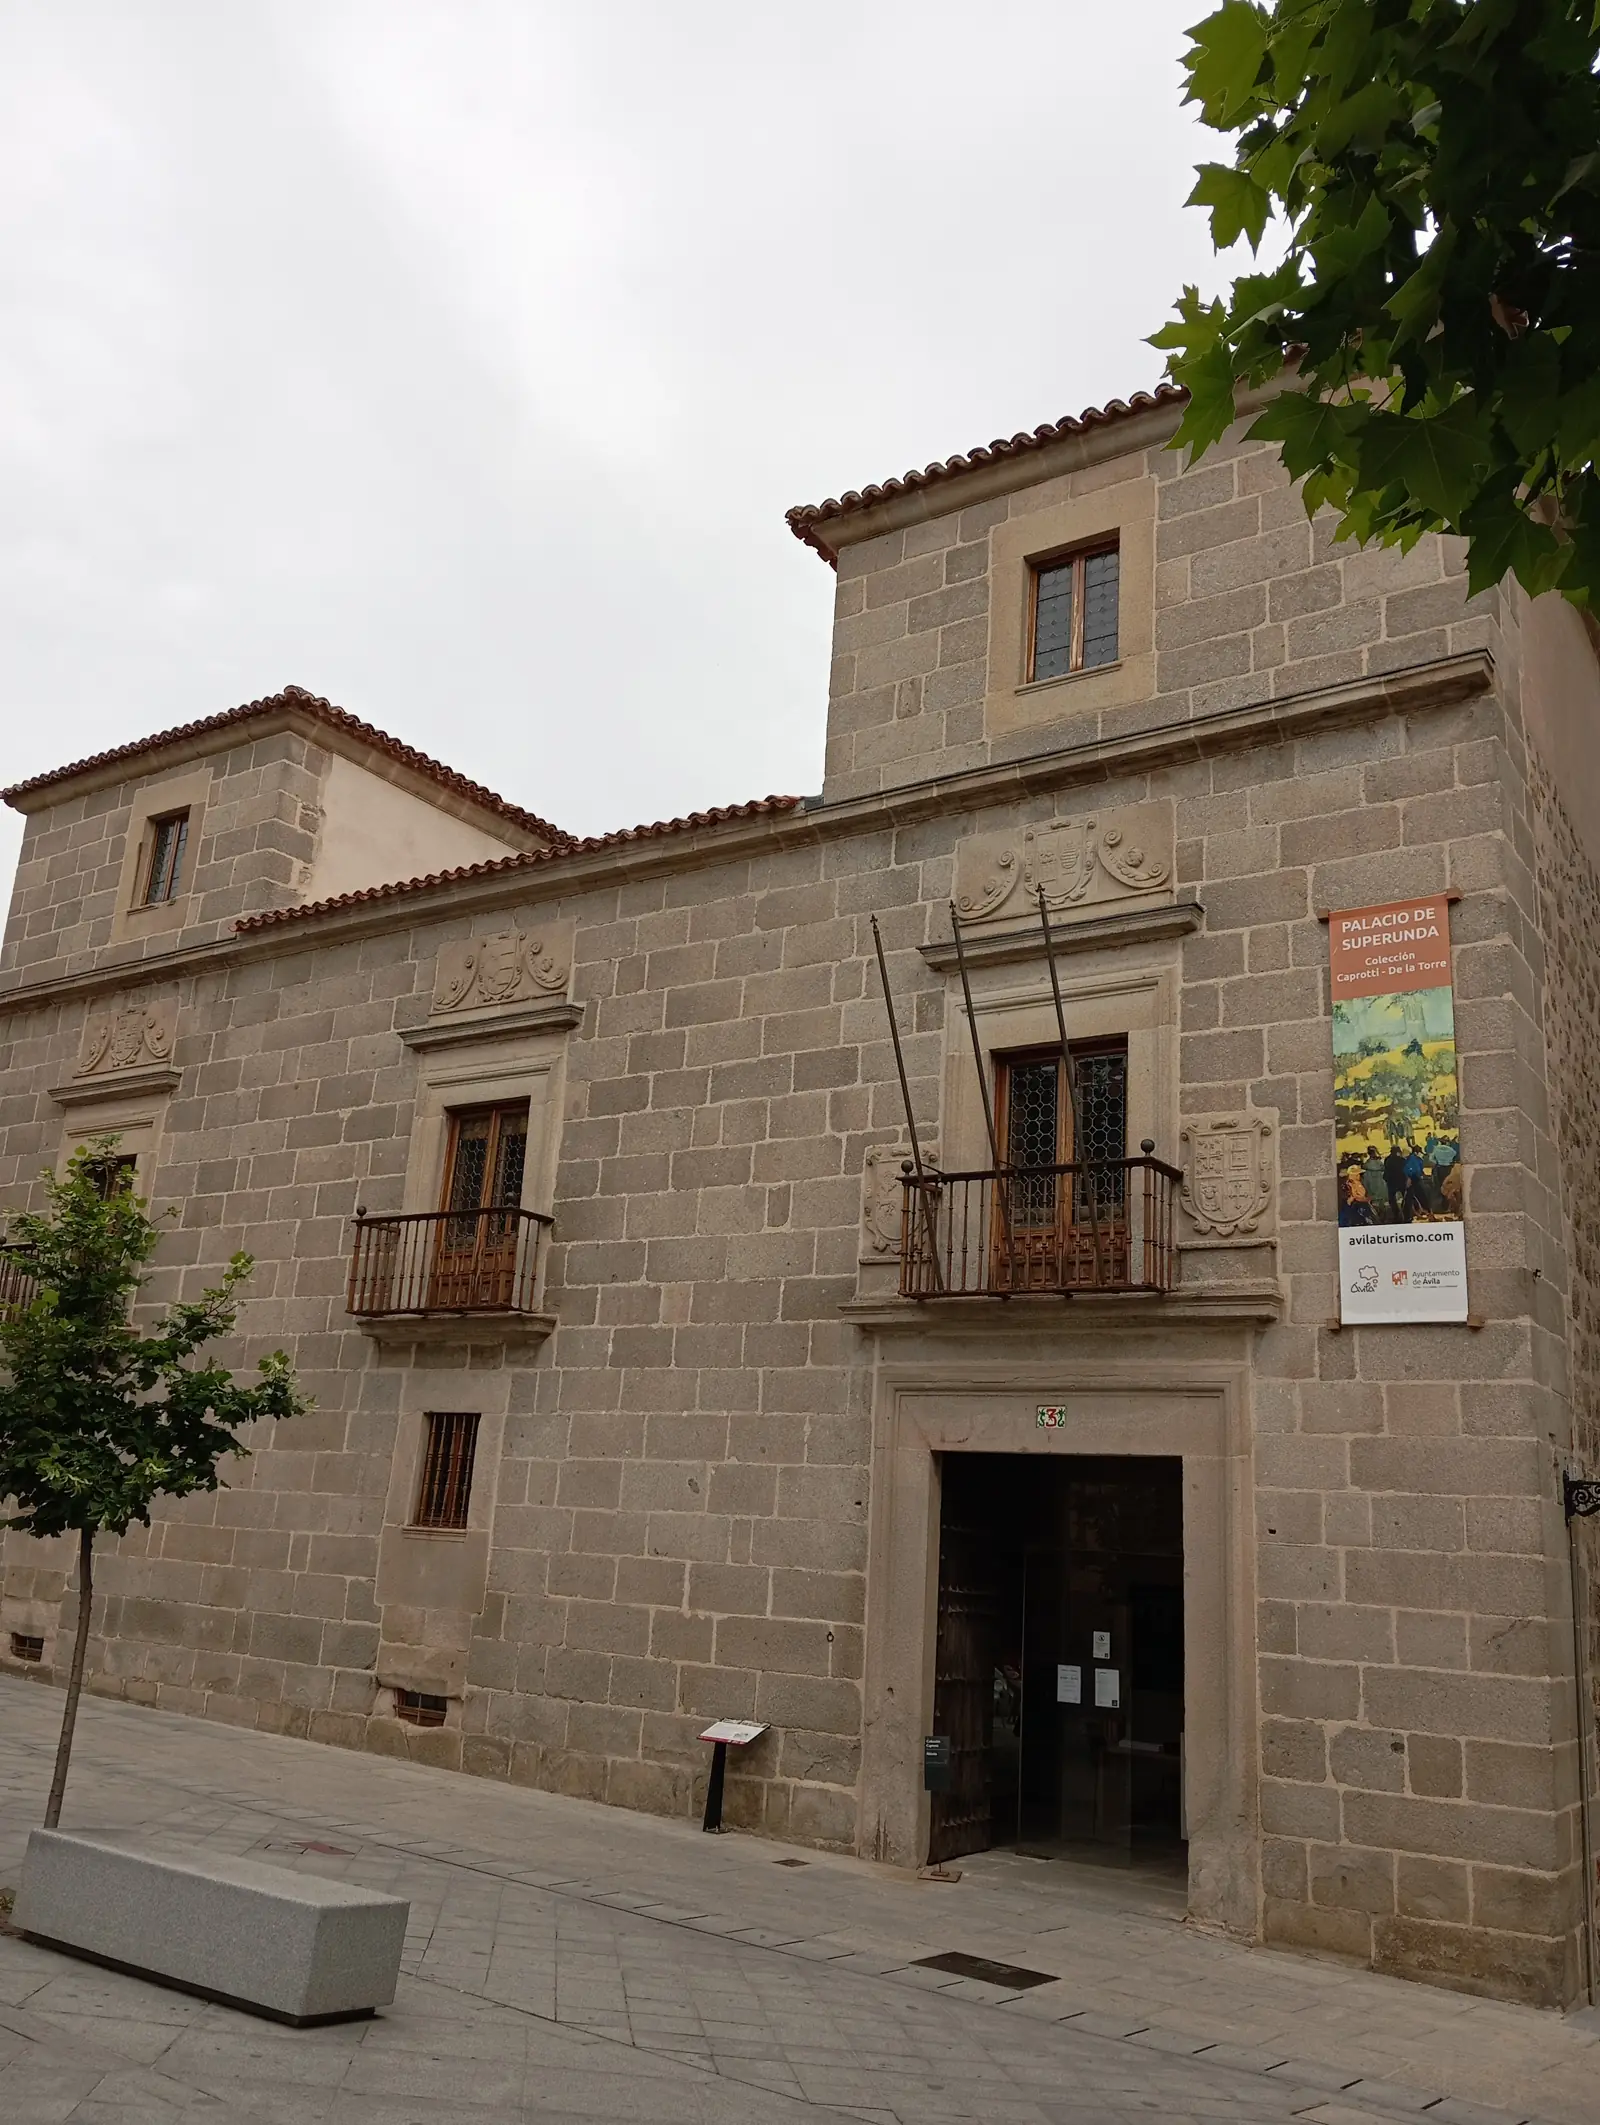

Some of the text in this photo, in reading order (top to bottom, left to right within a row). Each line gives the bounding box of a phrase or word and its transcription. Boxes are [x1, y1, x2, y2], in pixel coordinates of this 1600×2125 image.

[1342, 908, 1436, 933] PALACIO DE
[1342, 926, 1439, 951] SUPERUNDA
[1365, 952, 1415, 966] Colección
[1337, 966, 1379, 982] Caprotti
[1388, 965, 1402, 975] De
[1405, 963, 1415, 973] la
[1418, 960, 1447, 971] Torre
[1349, 1233, 1454, 1246] avilaturismo.com
[1412, 1269, 1460, 1278] Ayuntamiento
[1423, 1276, 1441, 1285] Ávila
[1046, 1408, 1057, 1427] 3
